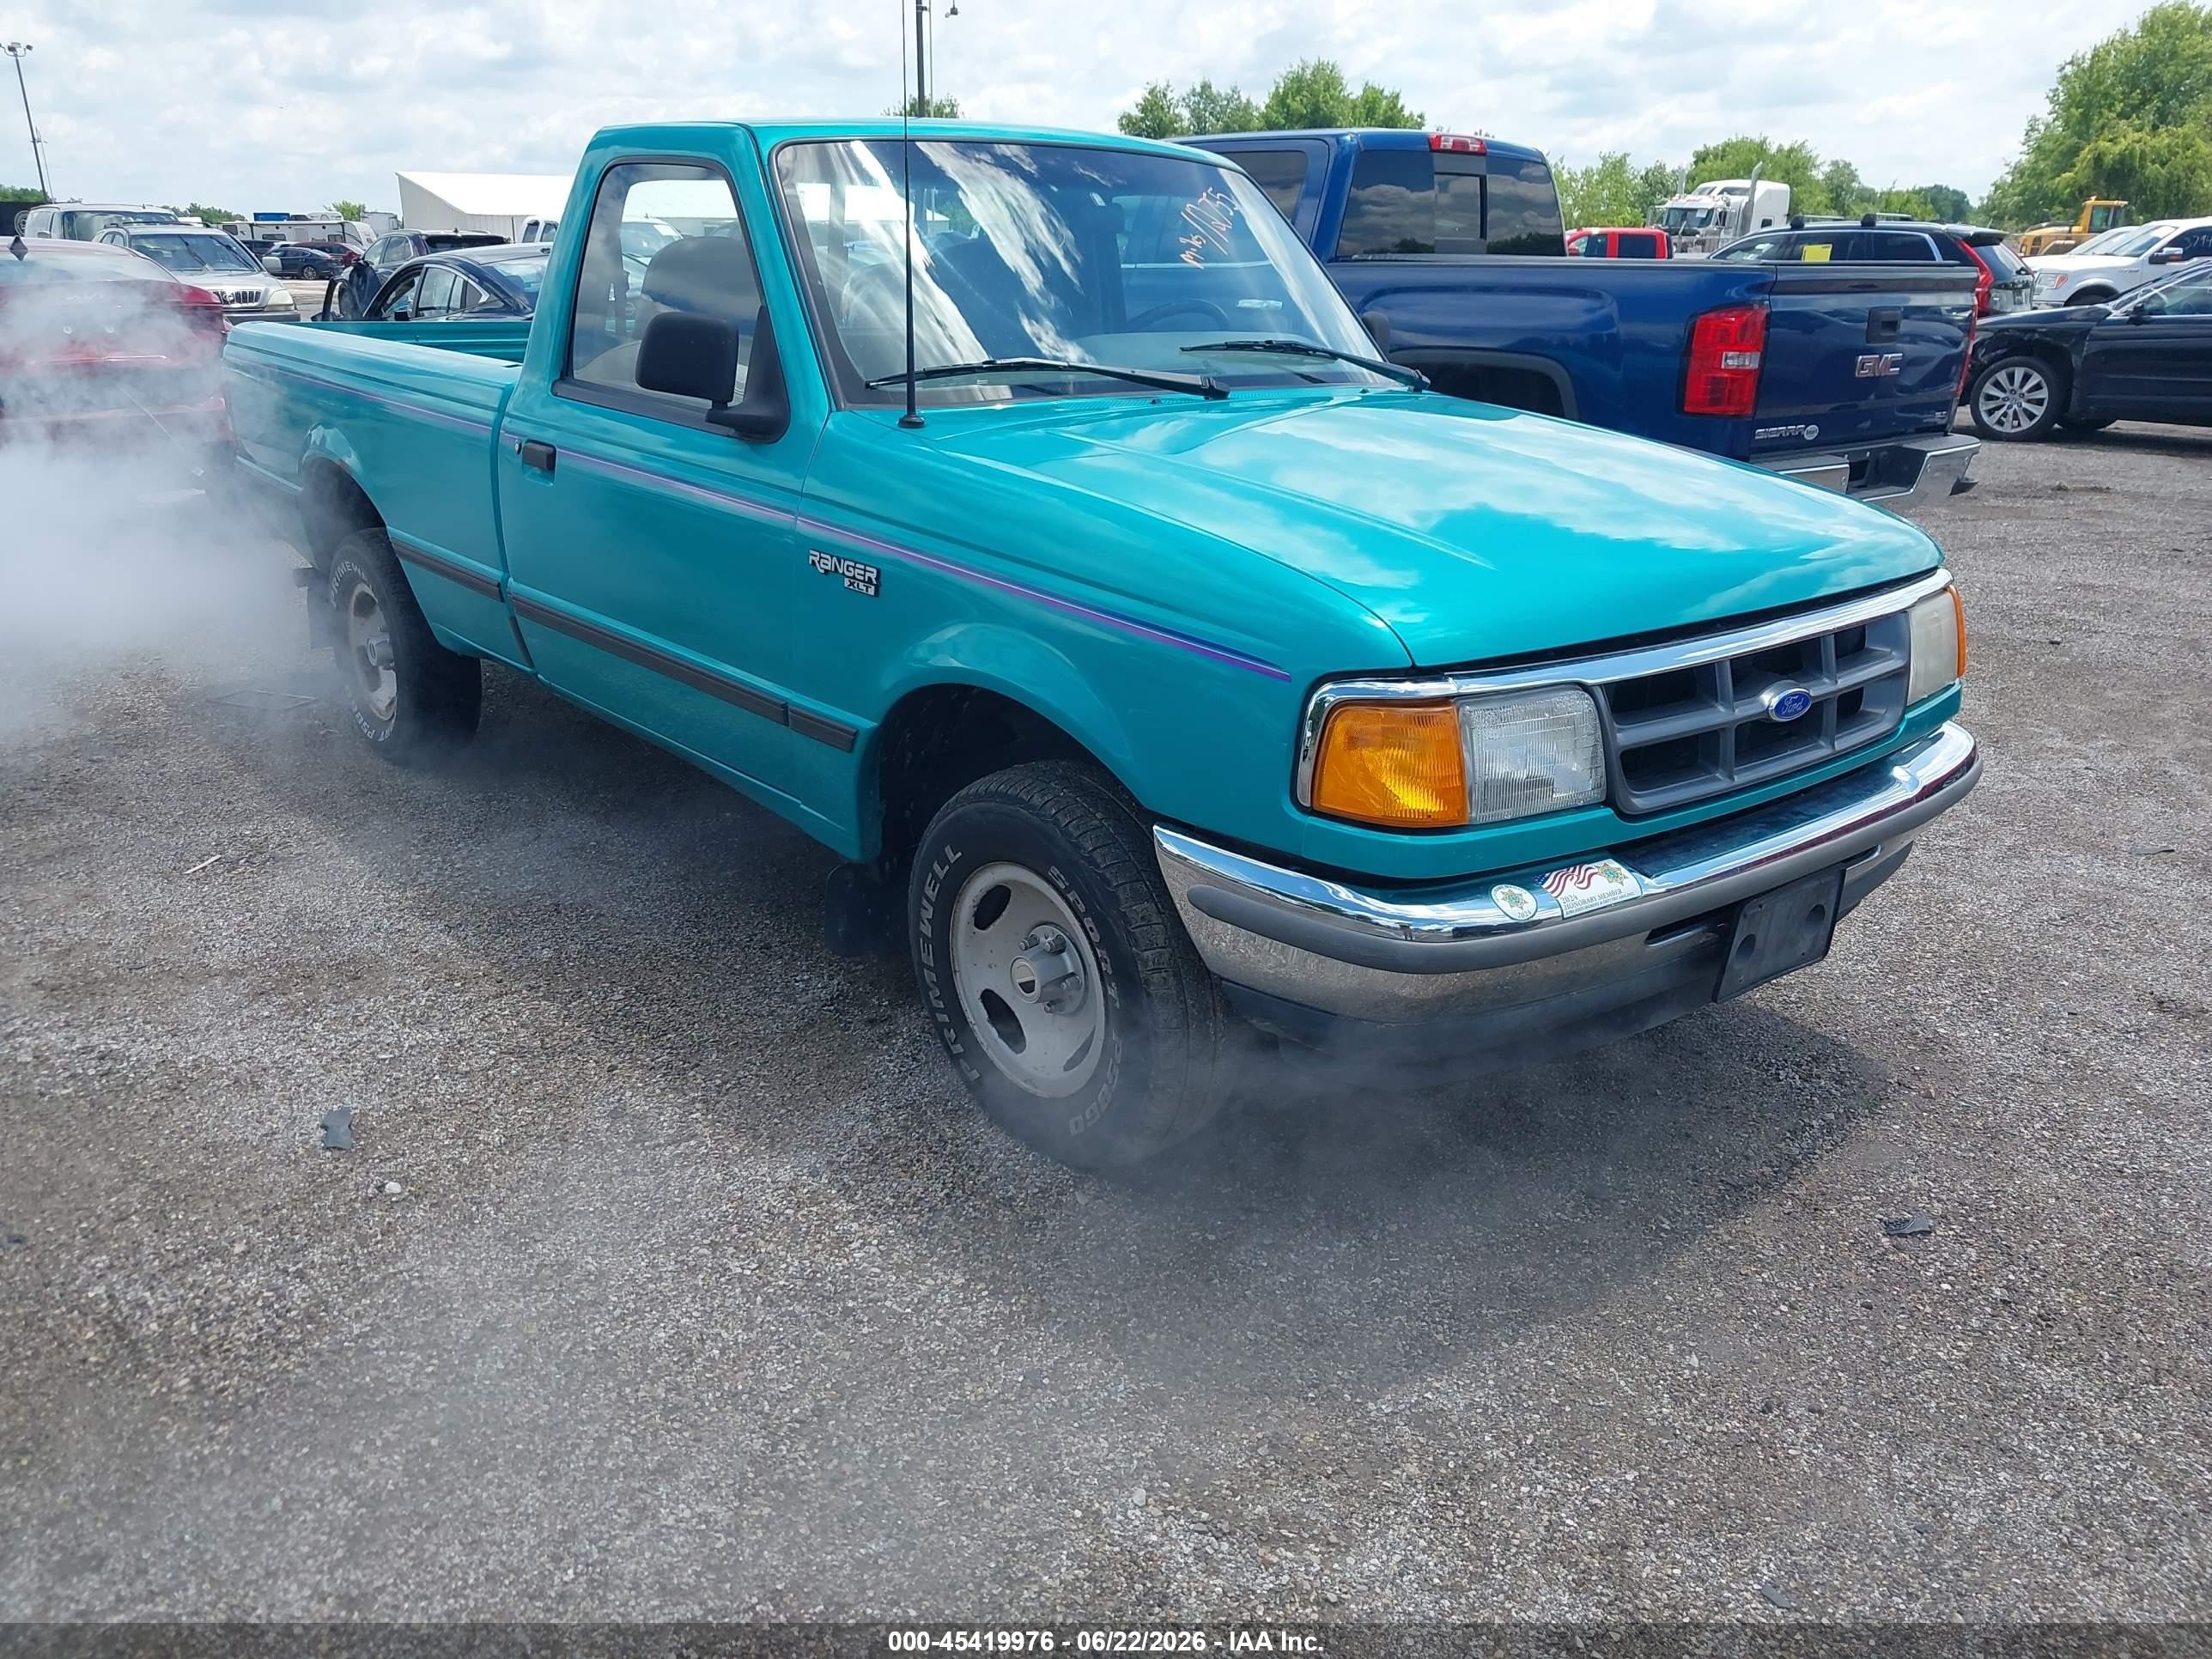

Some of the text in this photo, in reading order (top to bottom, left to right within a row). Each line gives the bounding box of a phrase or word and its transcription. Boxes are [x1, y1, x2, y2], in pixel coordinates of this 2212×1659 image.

[1855, 353, 1903, 378] GMC
[1754, 424, 1806, 440] SIERRA
[808, 550, 878, 585] RANGER
[331, 562, 373, 609] PRIMEW
[847, 578, 873, 594] XLT
[1781, 695, 1804, 715] Ford
[1597, 888, 1624, 902] MEMBER
[919, 844, 981, 1082] PRIMEWELL
